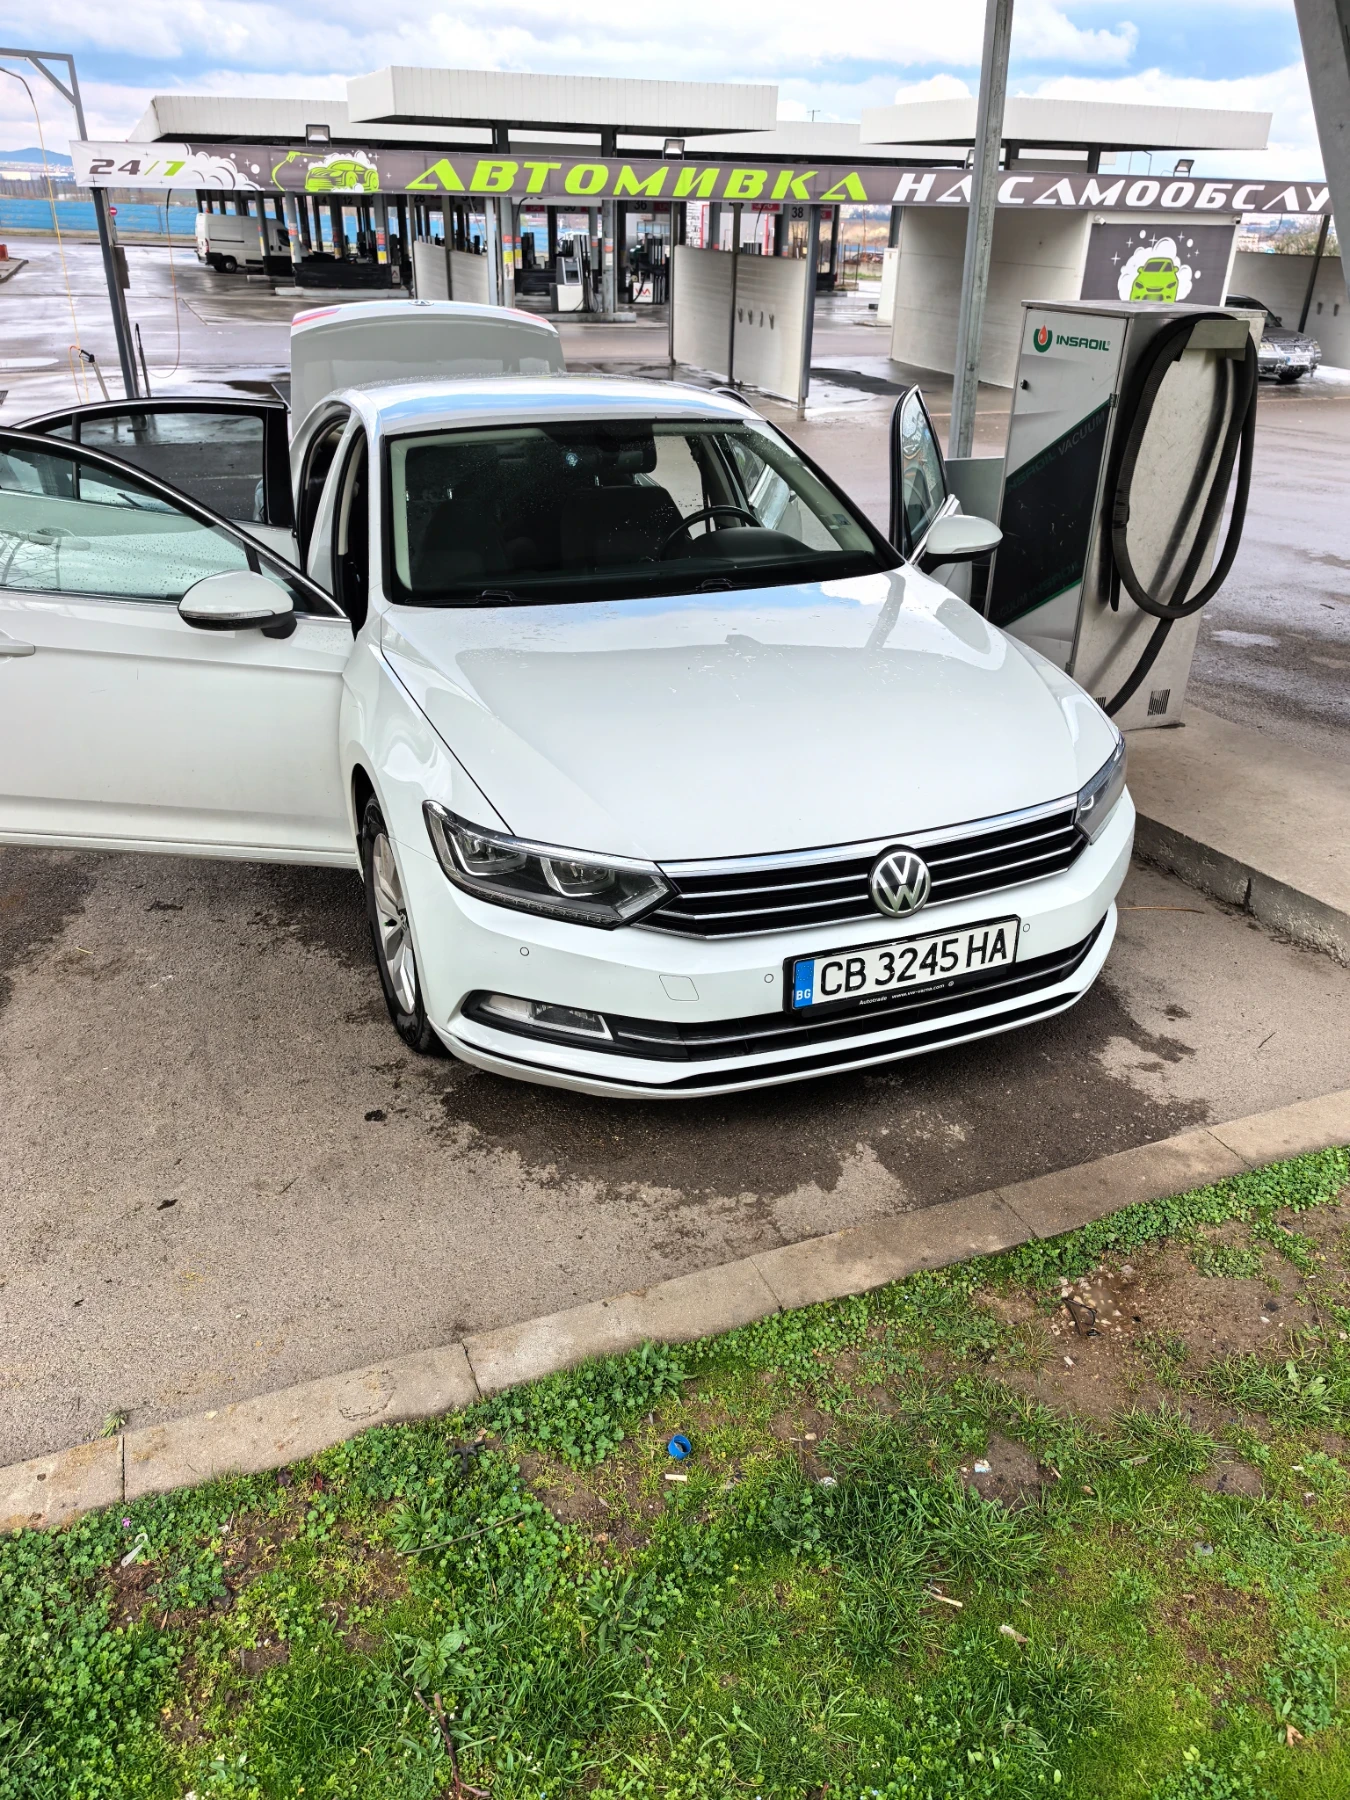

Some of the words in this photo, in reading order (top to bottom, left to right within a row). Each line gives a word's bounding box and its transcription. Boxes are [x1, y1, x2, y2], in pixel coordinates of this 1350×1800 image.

[89, 159, 186, 176] 24/7
[404, 158, 869, 202] АВТОМИВКА
[892, 173, 972, 203] НА
[792, 207, 804, 218] 38
[1058, 411, 1106, 456] VACUUM
[820, 958, 867, 996] CB
[875, 938, 960, 986] 3245
[965, 927, 1008, 968] HA
[796, 988, 811, 1001] BG
[859, 996, 888, 1005] Autotrade
